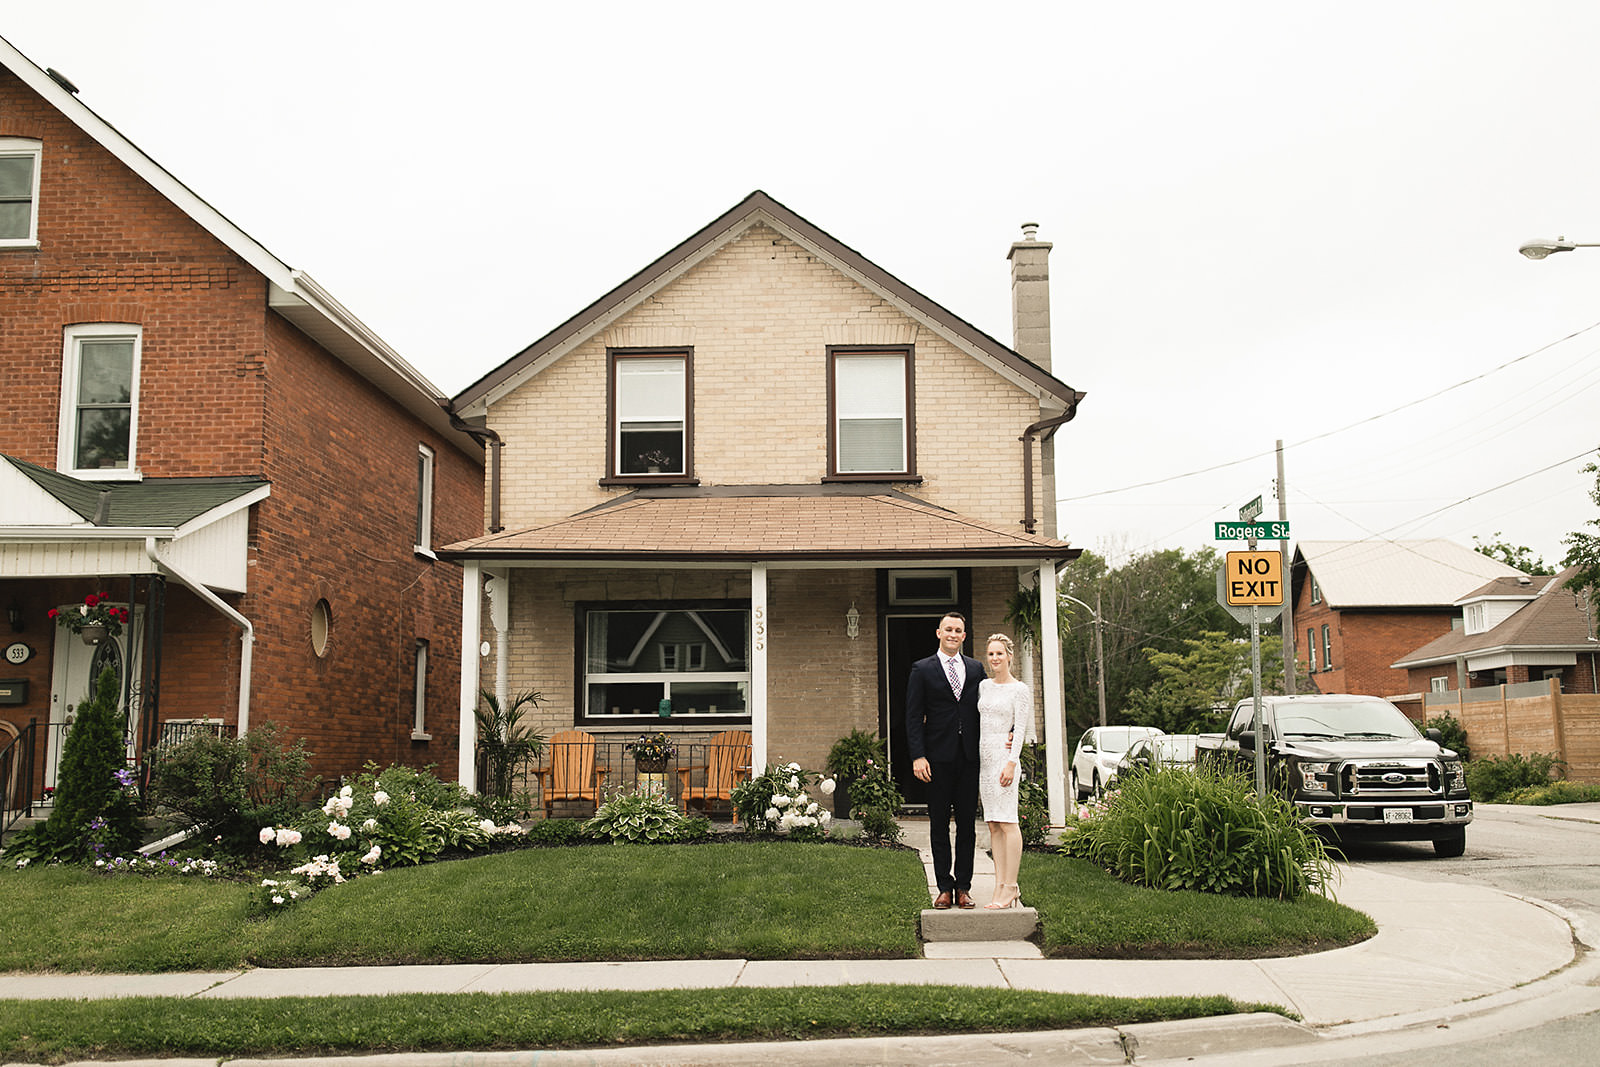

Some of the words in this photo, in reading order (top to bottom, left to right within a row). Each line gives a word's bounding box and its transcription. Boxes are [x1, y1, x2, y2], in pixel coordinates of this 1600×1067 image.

[1218, 524, 1265, 540] Rogers
[1238, 559, 1270, 575] NO
[1231, 581, 1278, 597] EXIT
[755, 606, 764, 651] 535
[12, 648, 24, 658] 533
